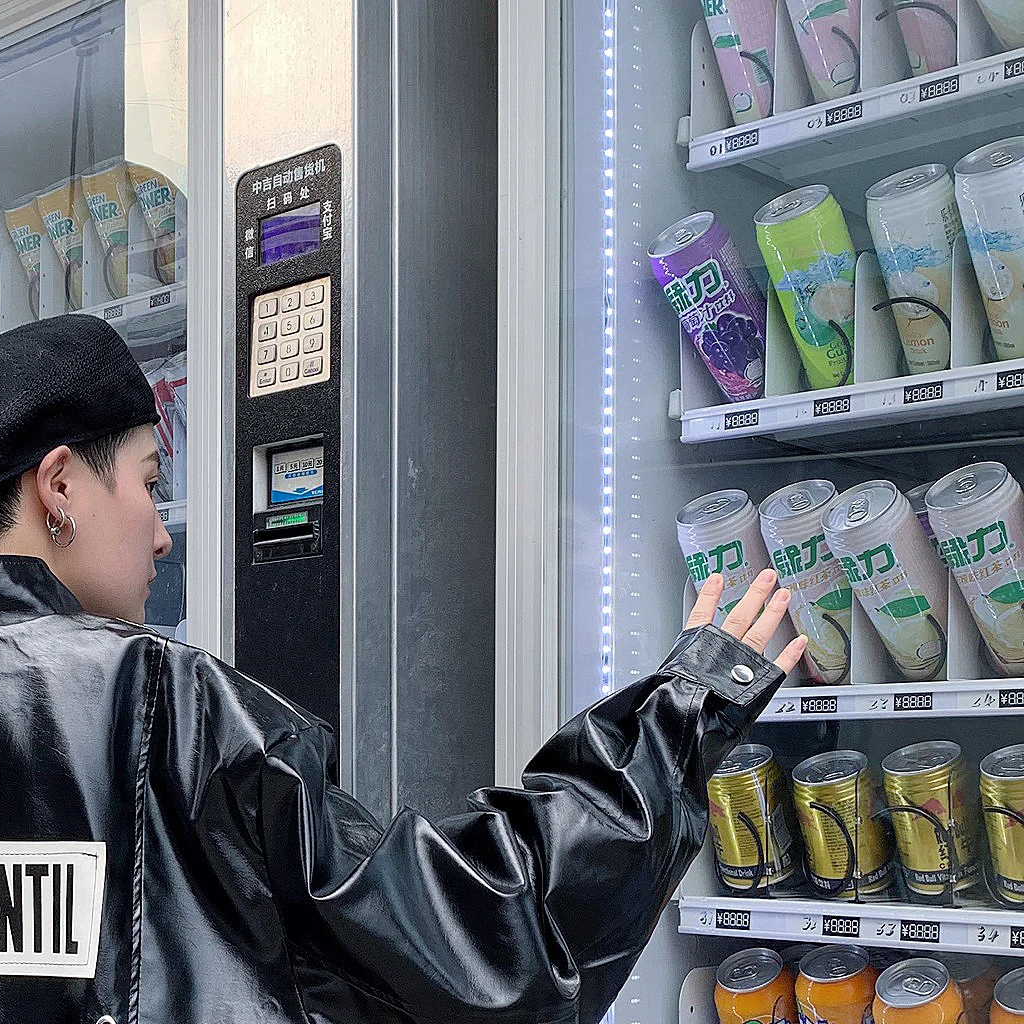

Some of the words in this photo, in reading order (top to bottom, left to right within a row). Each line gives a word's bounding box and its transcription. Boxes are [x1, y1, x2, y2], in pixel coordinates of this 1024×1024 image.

[710, 144, 722, 156] 01
[322, 200, 332, 240] 支付宝
